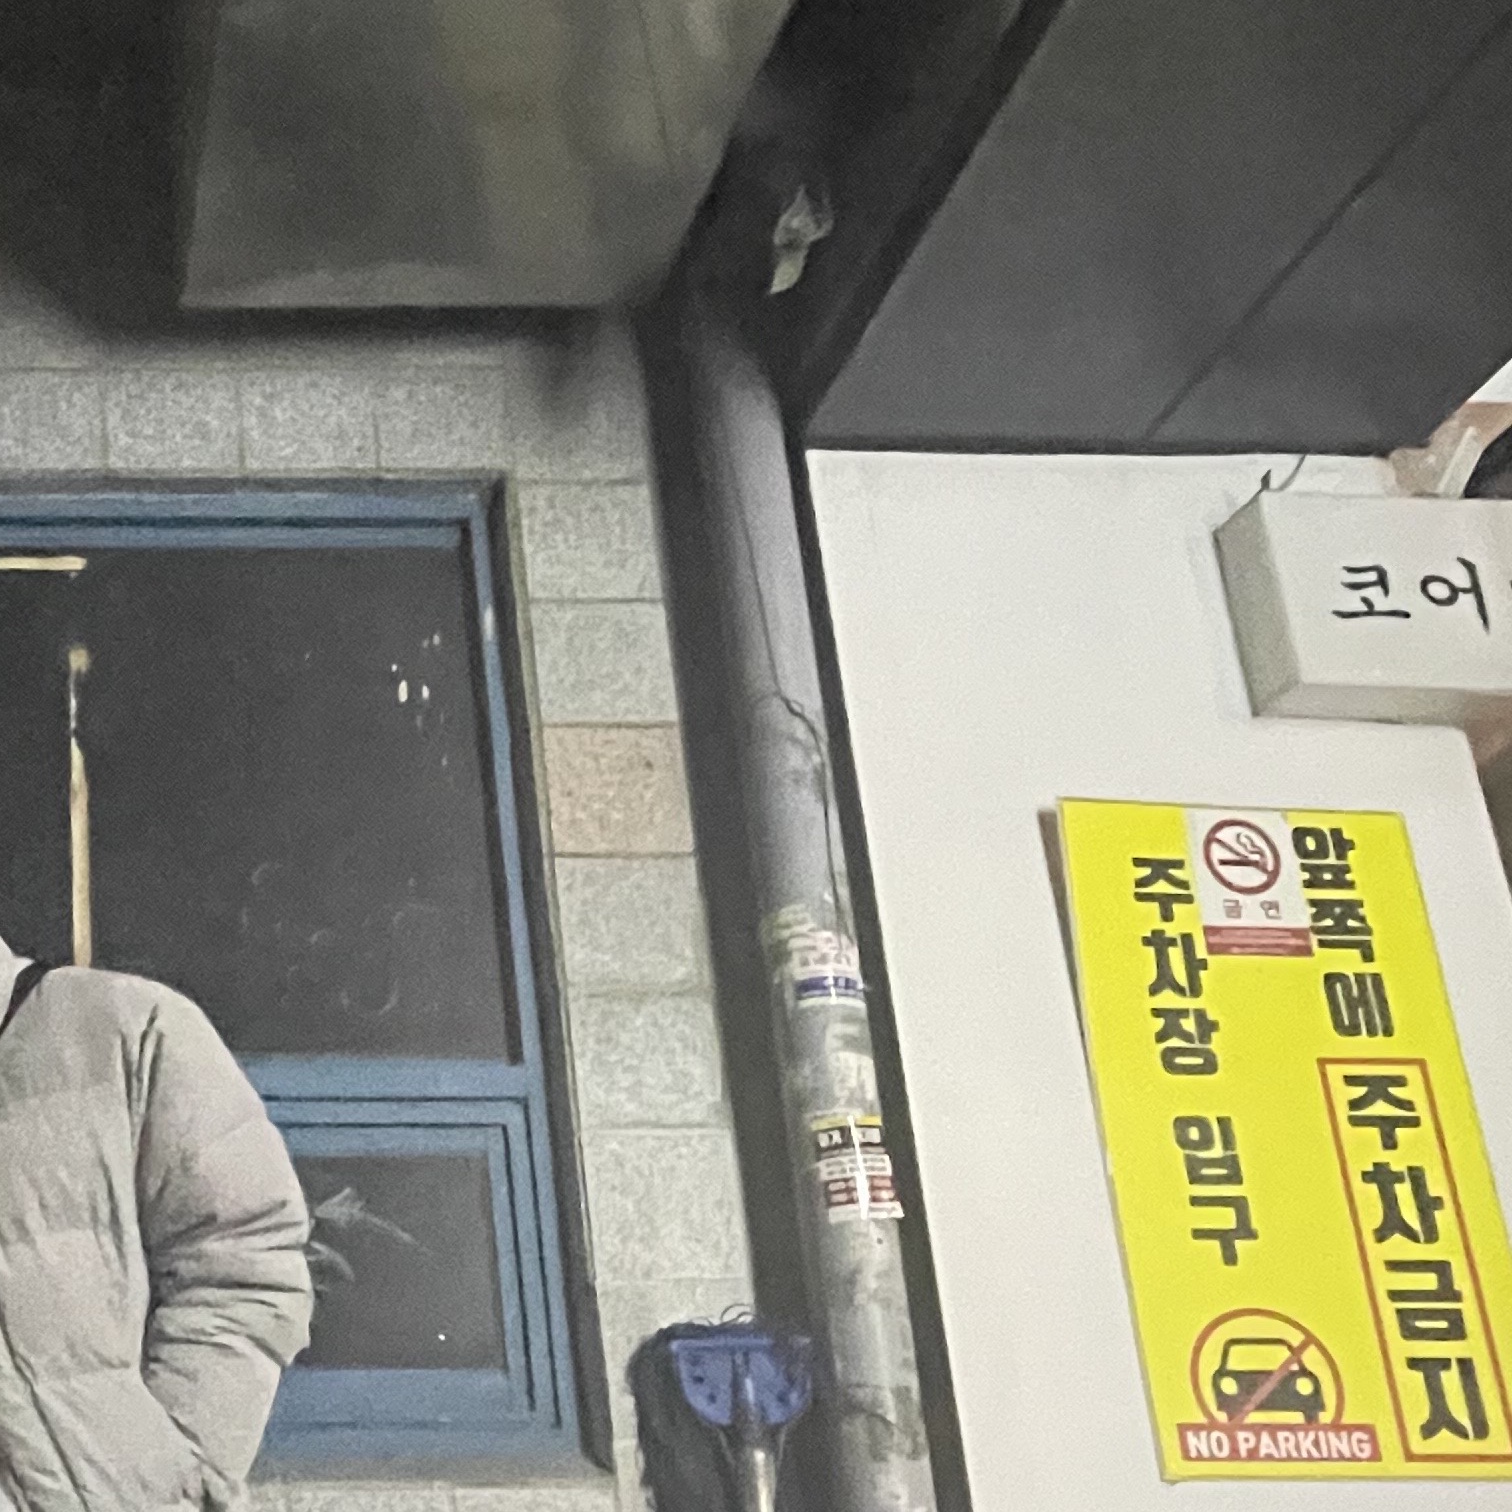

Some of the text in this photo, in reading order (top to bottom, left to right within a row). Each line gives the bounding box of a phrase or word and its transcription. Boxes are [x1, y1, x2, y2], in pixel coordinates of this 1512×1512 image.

[1332, 556, 1512, 634] 코어
[1291, 825, 1394, 1039] 앞쪽에
[1131, 856, 1259, 1267] 주차장 입구
[1341, 1073, 1491, 1442] 주차금지
[1186, 1429, 1373, 1460] NO PARKING
